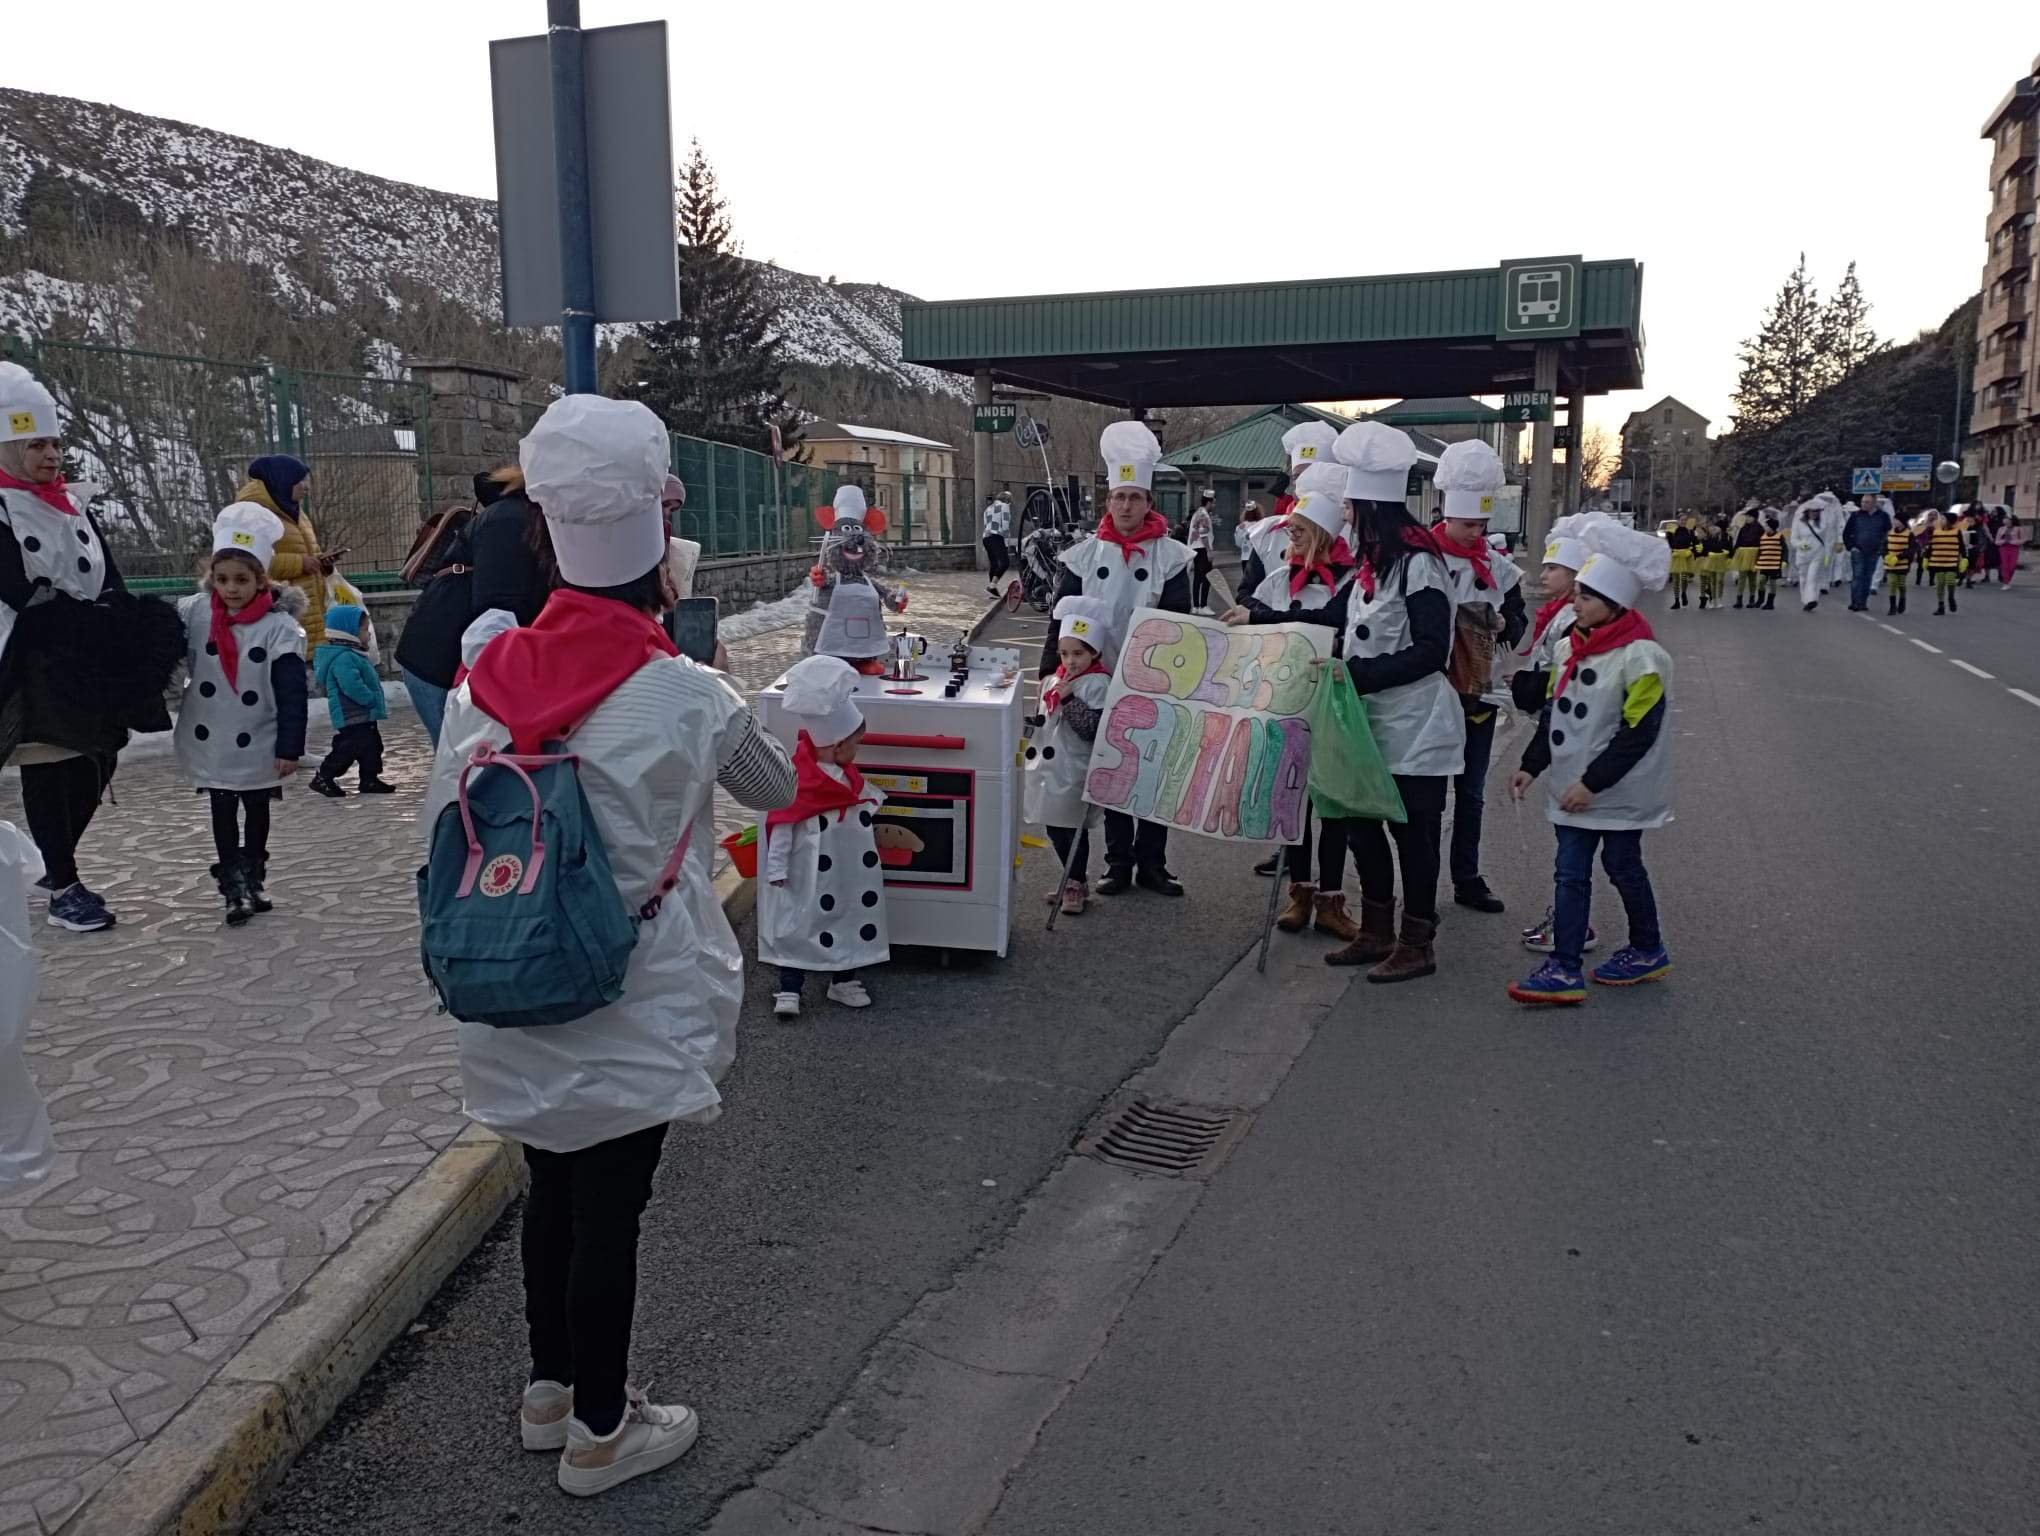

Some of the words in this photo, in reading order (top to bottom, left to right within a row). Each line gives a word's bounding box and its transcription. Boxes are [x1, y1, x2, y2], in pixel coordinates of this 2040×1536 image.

[1505, 392, 1549, 406] ANDEN
[976, 405, 1015, 418] ANDEN
[1521, 408, 1531, 420] 2
[992, 418, 999, 430] 1
